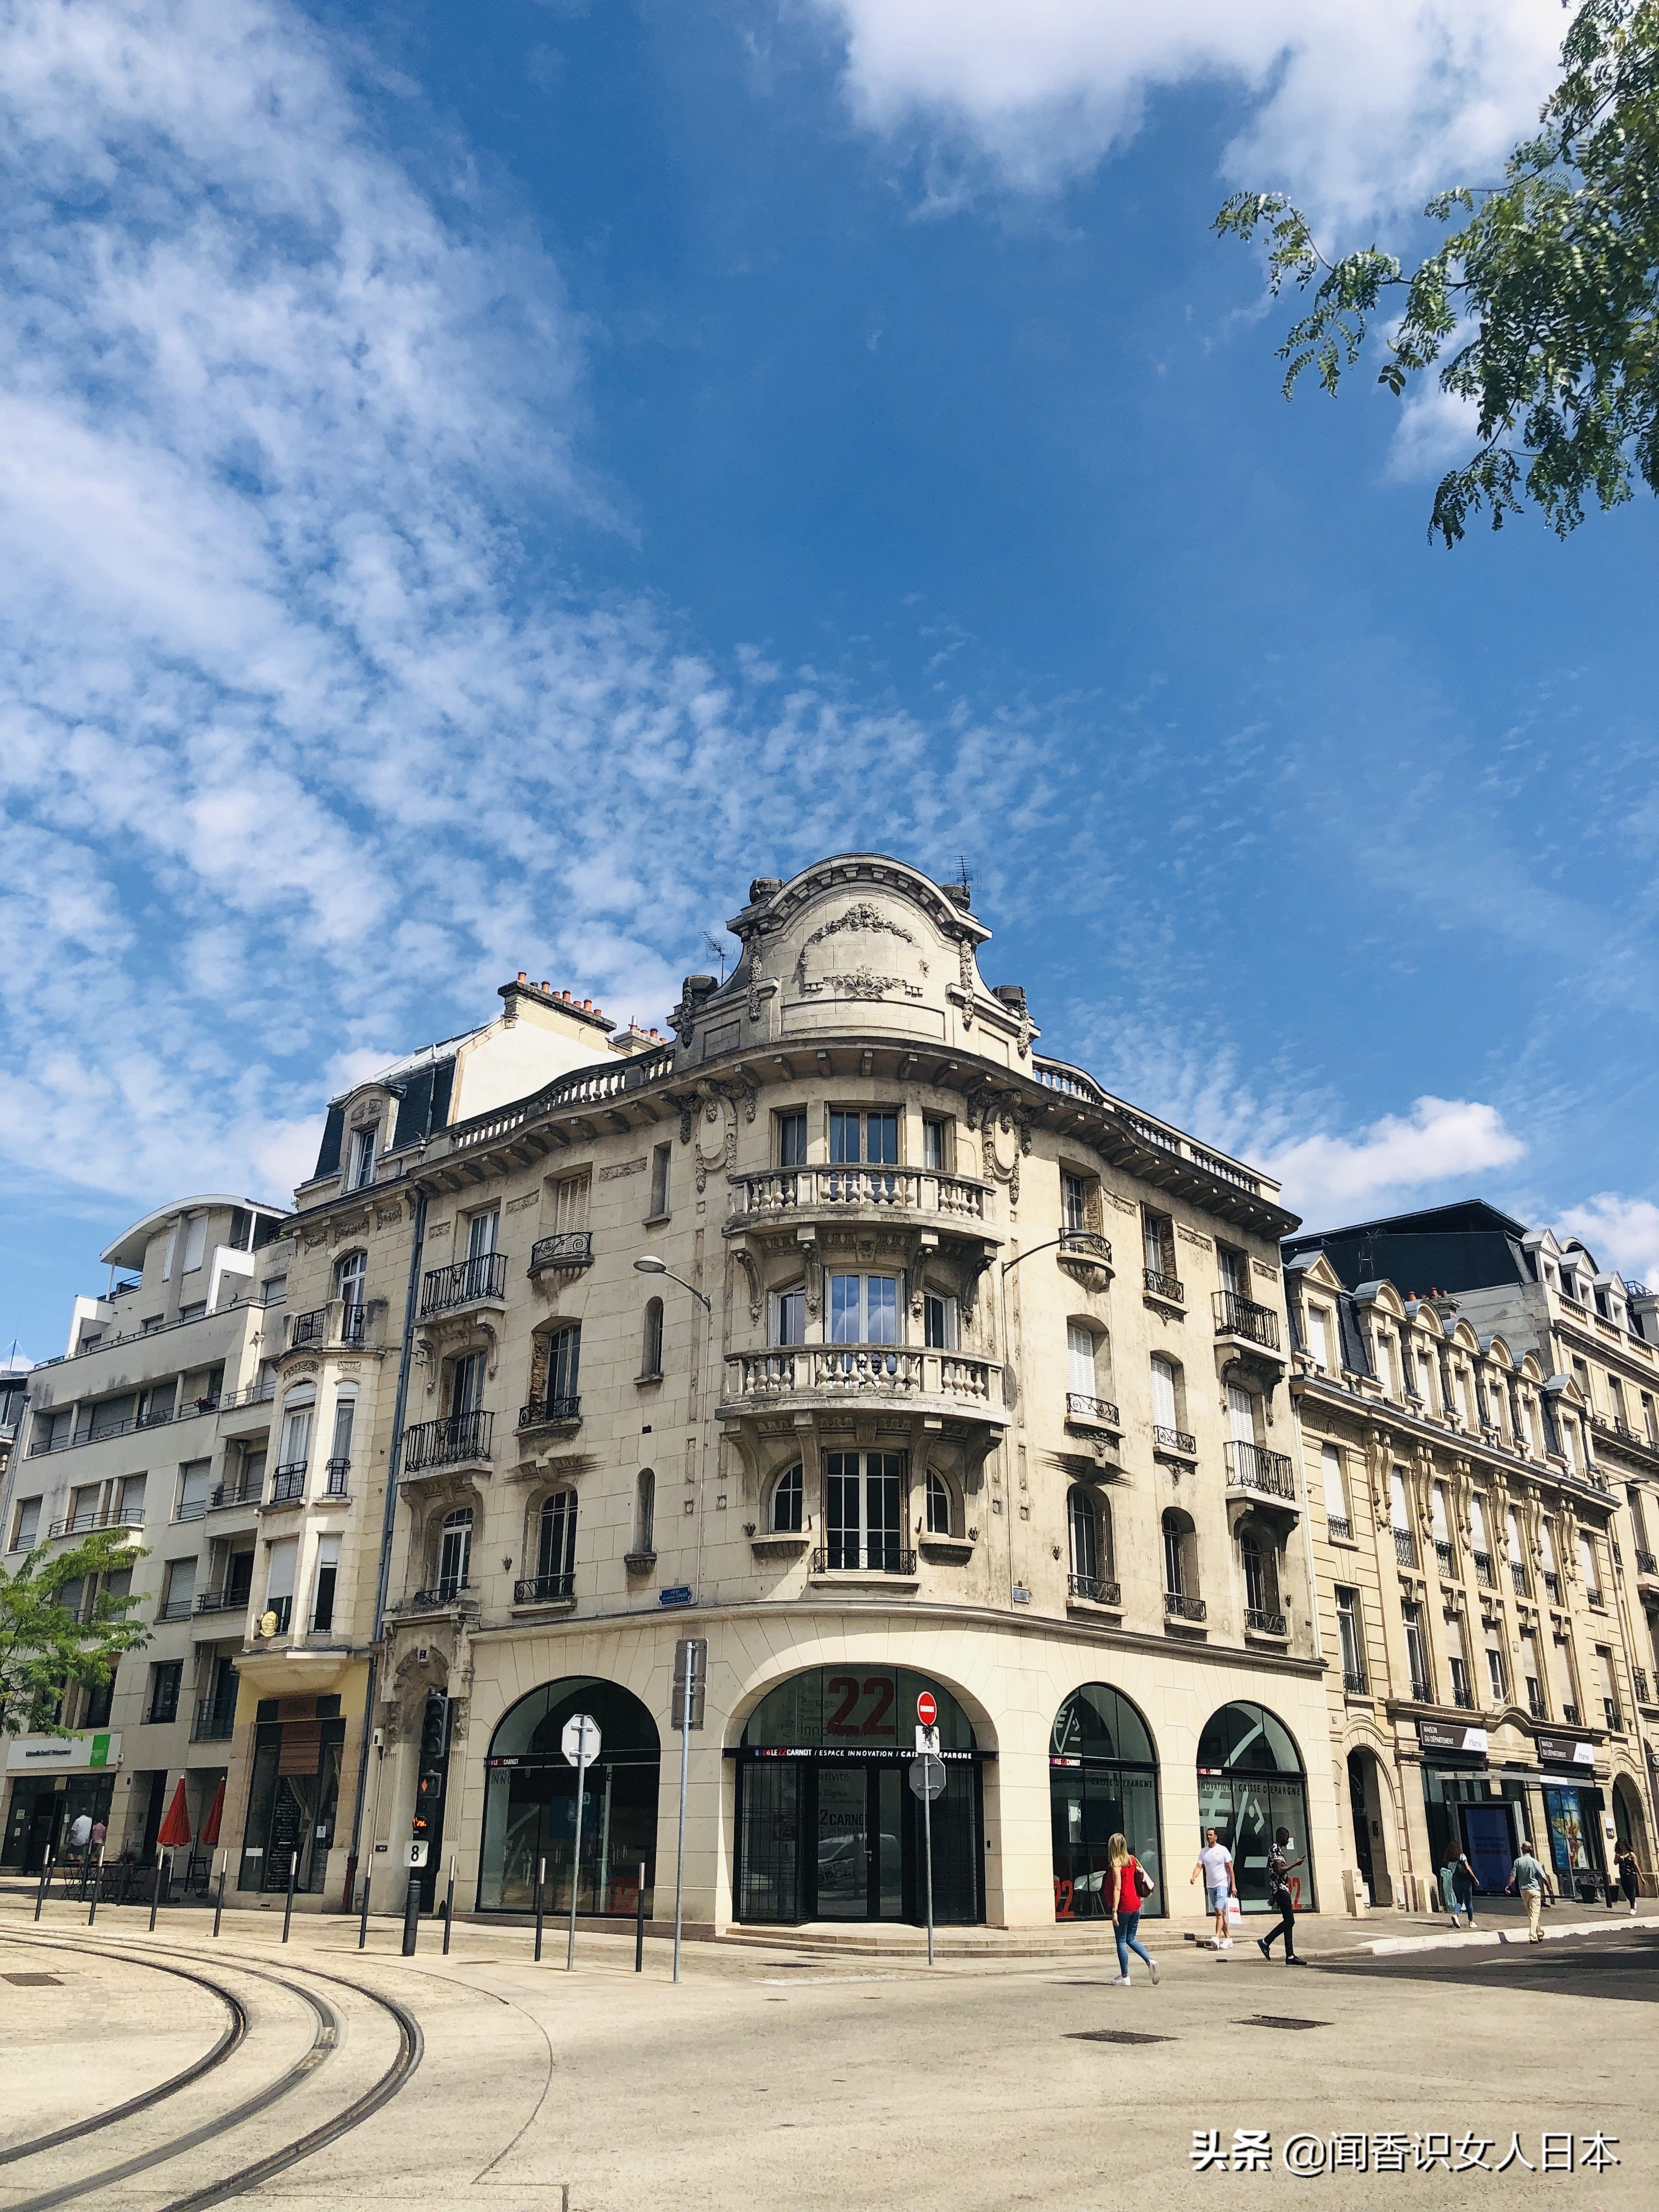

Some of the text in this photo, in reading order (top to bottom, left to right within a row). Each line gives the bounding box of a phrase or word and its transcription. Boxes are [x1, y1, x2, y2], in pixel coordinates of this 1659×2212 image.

[828, 1677, 895, 1735] 22
[778, 1747, 786, 1756] 22
[1238, 1784, 1261, 1793] CAISSE
[819, 1809, 866, 1825] 2 CARNO
[411, 1845, 419, 1861] 8
